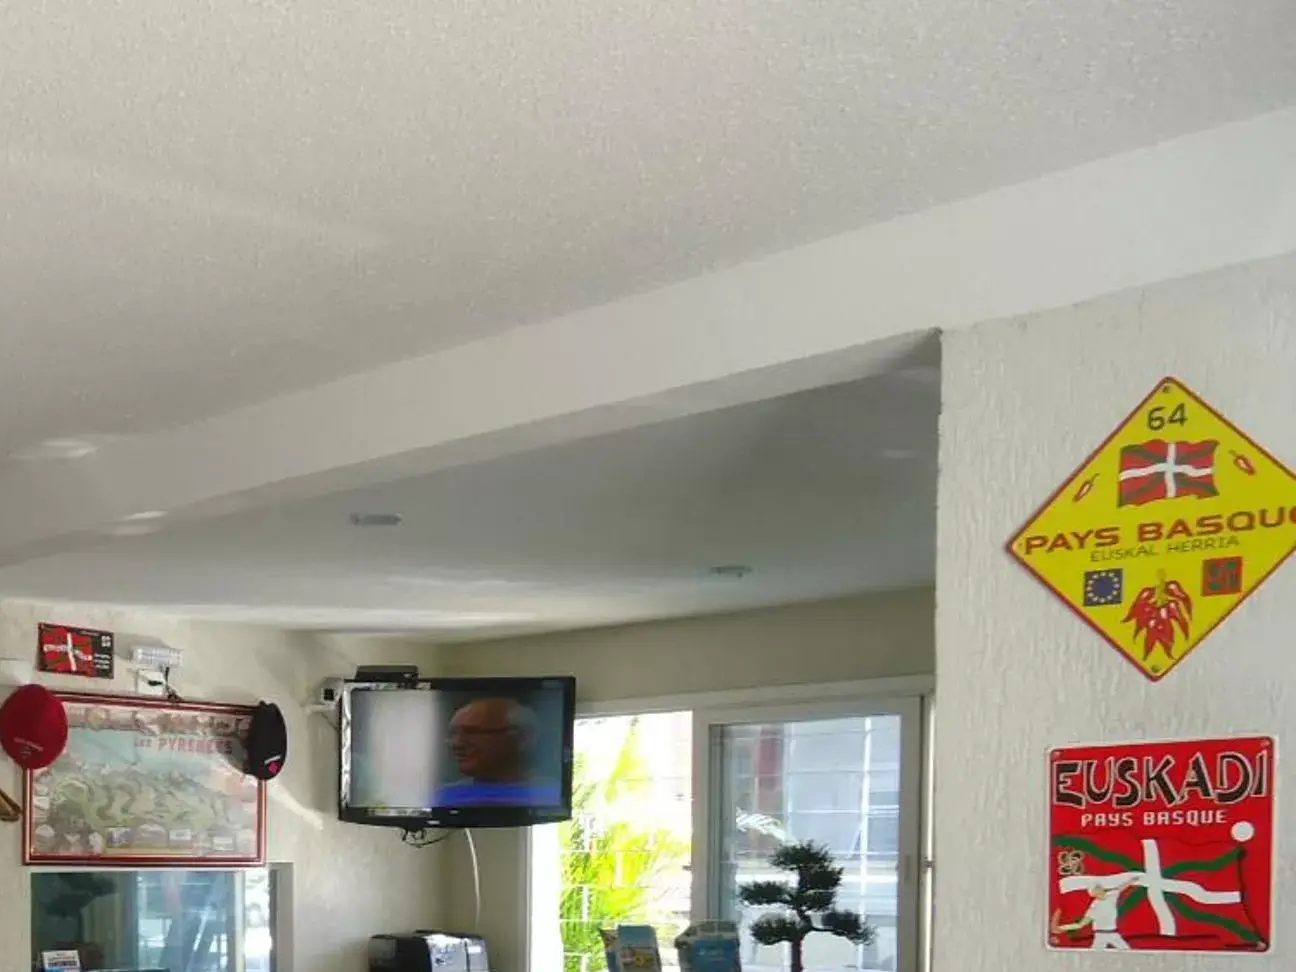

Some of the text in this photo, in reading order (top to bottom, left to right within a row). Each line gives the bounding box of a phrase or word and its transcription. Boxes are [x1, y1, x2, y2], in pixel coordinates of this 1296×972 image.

[1147, 403, 1188, 431] 64
[1024, 527, 1120, 555] PAYS
[1090, 535, 1240, 563] EUSKAL HERRIA
[1053, 750, 1268, 808] EUSKADI
[1081, 809, 1229, 828] PAYS BASQUE
